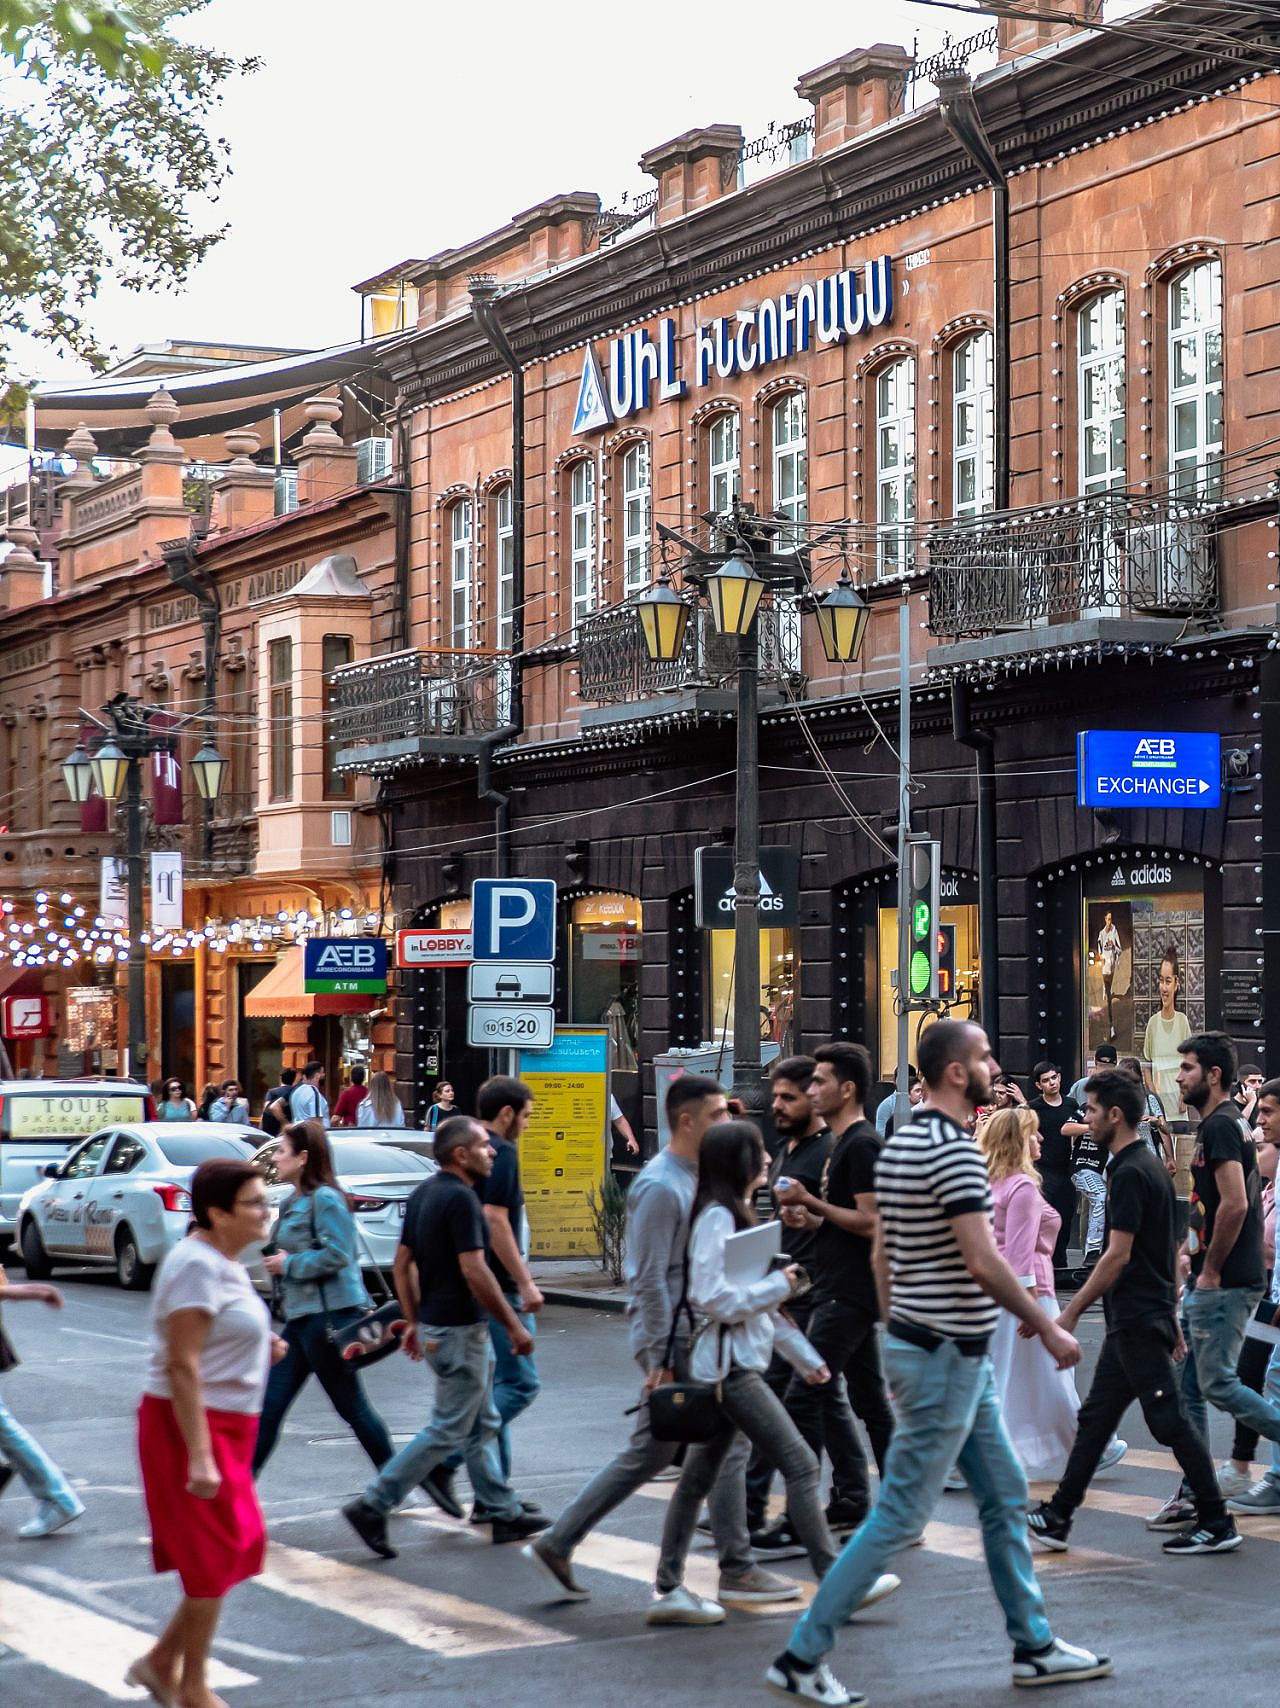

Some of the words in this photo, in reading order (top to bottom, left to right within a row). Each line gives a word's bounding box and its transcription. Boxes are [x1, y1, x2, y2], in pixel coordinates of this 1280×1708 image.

[610, 316, 687, 419] ՍԻԼ
[149, 598, 197, 628] TREASUR
[226, 582, 243, 608] OF
[248, 561, 306, 601] ARMENIA
[1134, 739, 1176, 755] AEB
[1097, 777, 1198, 795] EXCHANGE
[1131, 864, 1172, 885] adidas
[490, 888, 536, 954] P
[317, 945, 376, 967] AEB
[334, 982, 359, 991] ATM
[486, 1022, 497, 1032] 10
[500, 1019, 514, 1032] 15
[516, 1019, 537, 1034] 20
[42, 1099, 109, 1113] TOUR
